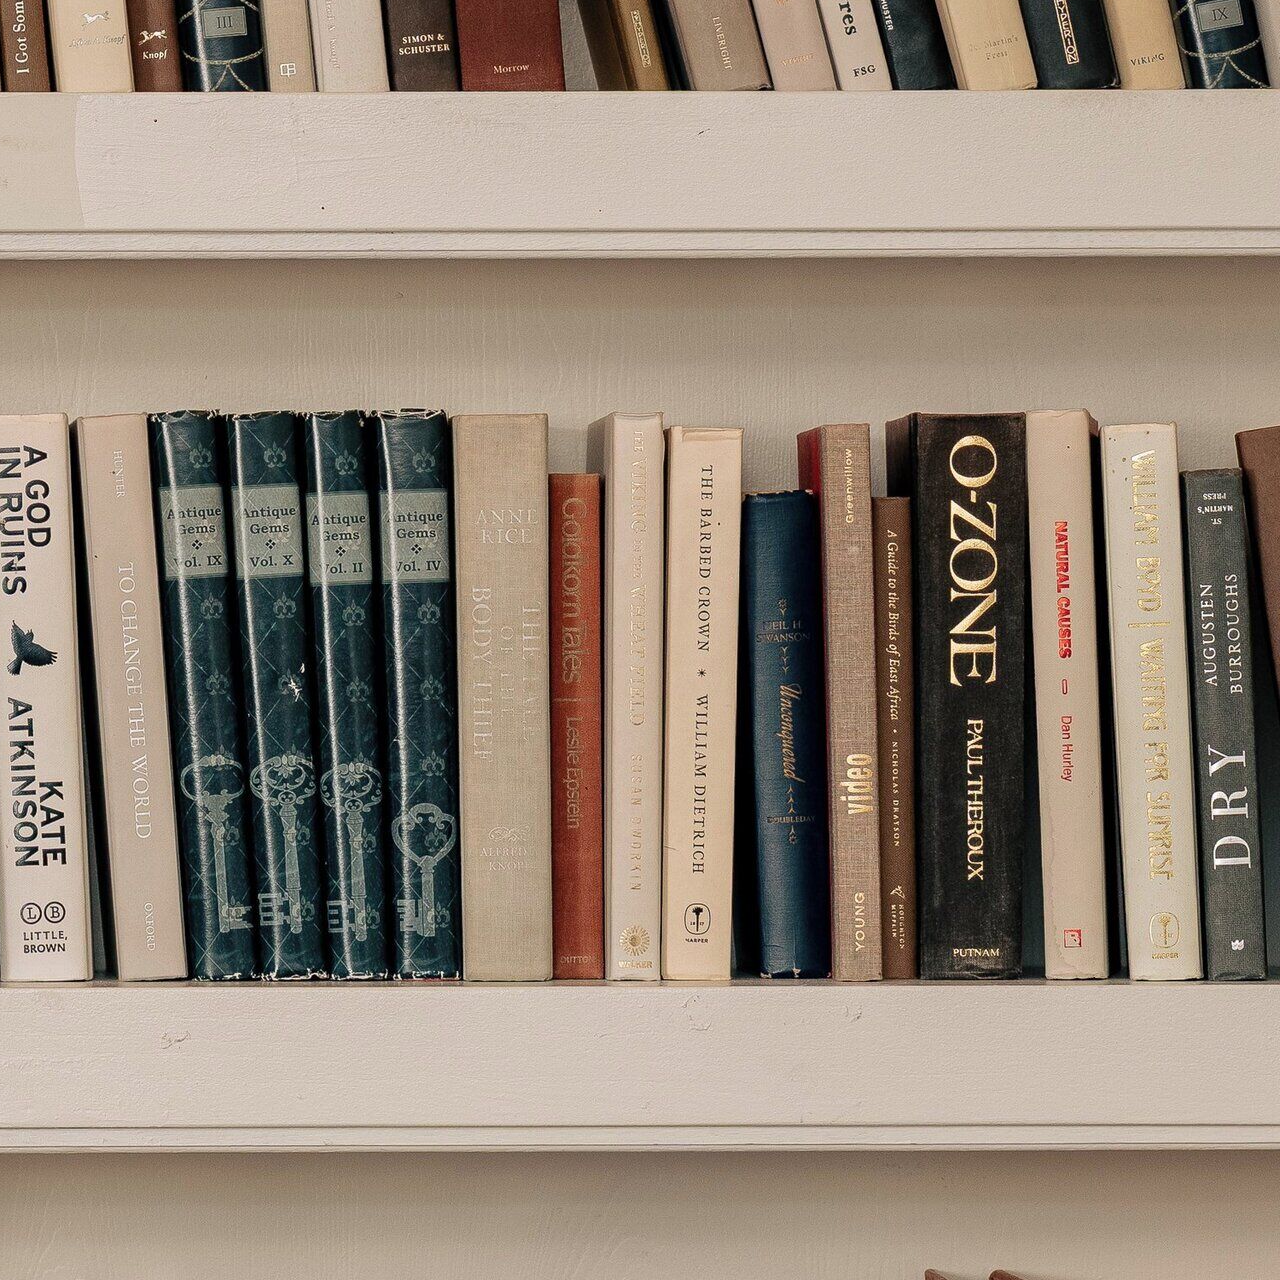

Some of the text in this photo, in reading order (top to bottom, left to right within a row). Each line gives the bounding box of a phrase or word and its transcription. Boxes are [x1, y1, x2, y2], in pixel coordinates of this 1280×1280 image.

[402, 34, 434, 43] SIMON
[398, 42, 450, 56] SCHUSTER
[493, 63, 529, 74] Morrow
[853, 64, 876, 77] FSG
[22, 444, 51, 548] A GOD
[949, 434, 998, 687] O-ZONE
[8, 696, 40, 868] ATKINSON
[967, 718, 984, 882] PAUL THEROUX
[39, 780, 67, 866] KATE
[23, 930, 68, 942] LITTLE,
[24, 943, 66, 953] BROWN
[953, 947, 1000, 958] PUTNAM
